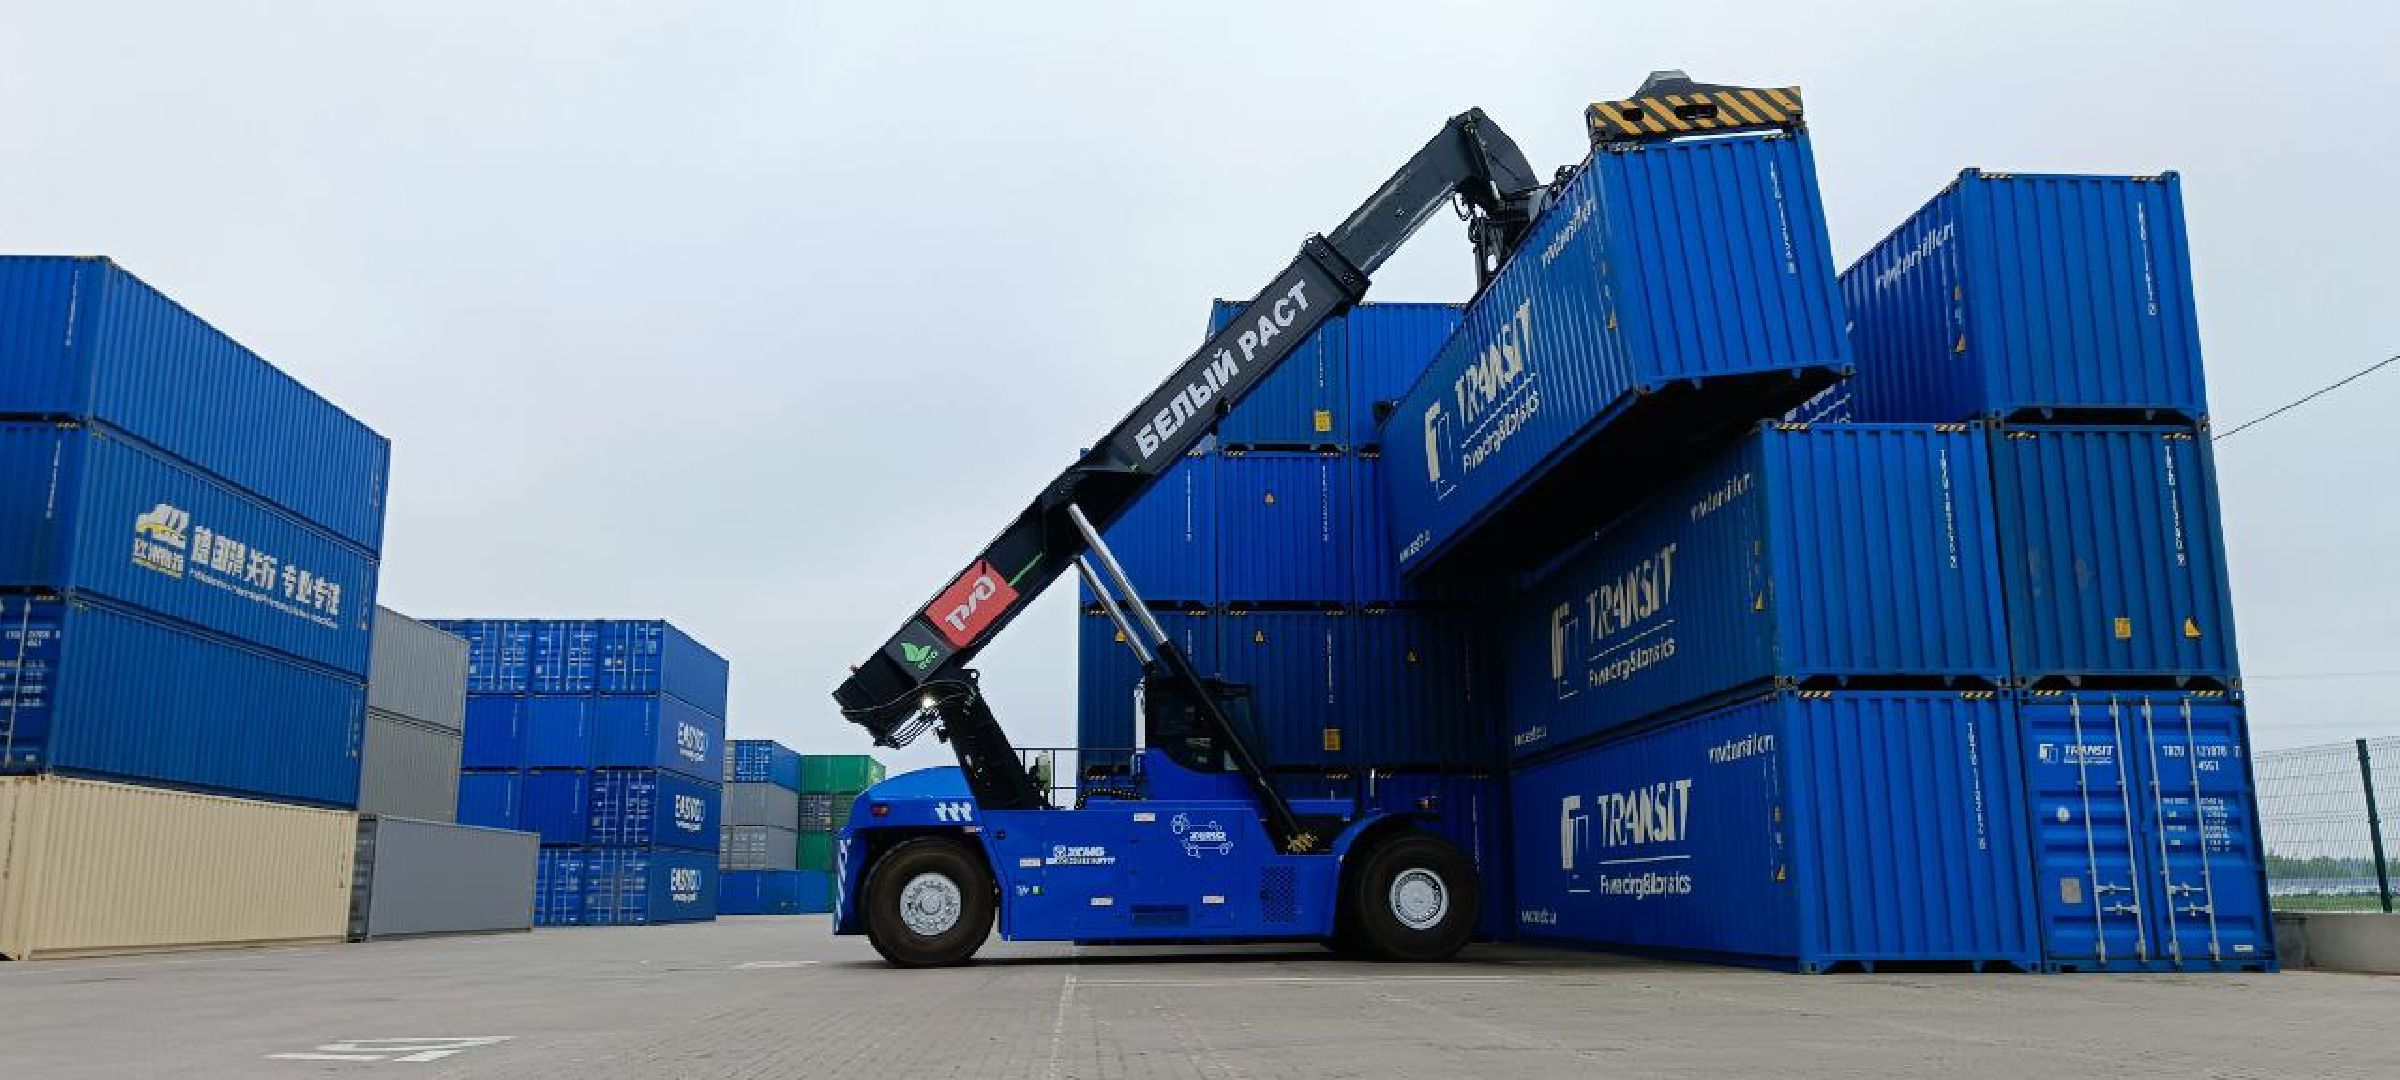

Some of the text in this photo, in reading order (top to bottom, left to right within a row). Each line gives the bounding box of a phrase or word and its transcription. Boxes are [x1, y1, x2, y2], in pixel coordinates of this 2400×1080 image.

[1134, 348, 1239, 459] БЕЛЫЙ
[1237, 279, 1309, 362] РАСТ
[1455, 298, 1531, 430] TRANSIT
[1586, 543, 1676, 643] TRANSIT
[1598, 779, 1692, 847] TRANSIT
